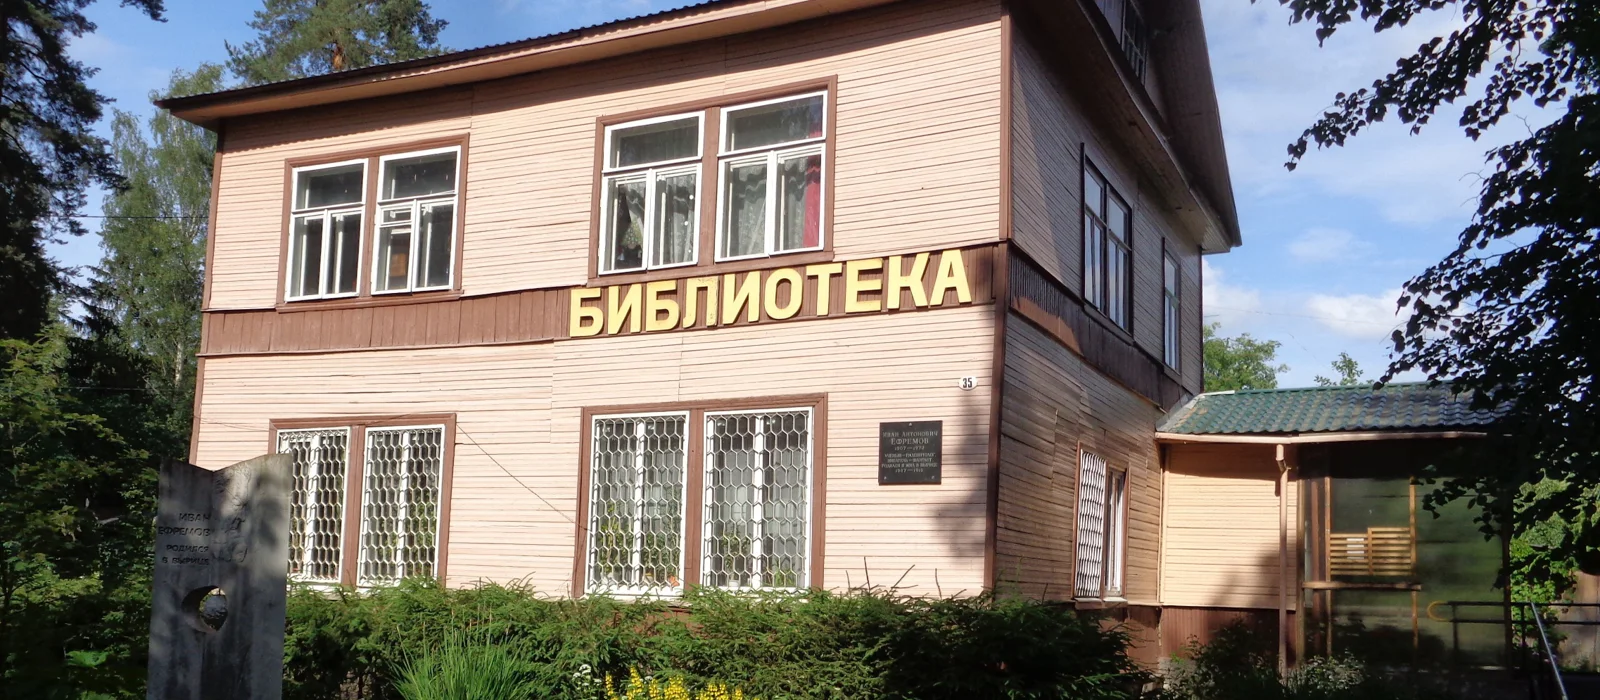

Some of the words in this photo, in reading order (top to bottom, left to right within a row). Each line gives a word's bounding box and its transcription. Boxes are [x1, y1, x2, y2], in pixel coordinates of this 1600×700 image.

[569, 249, 972, 337] БИБЛИОТЕКА
[962, 377, 973, 388] 35
[891, 437, 929, 445] ЕФРЕМОВ
[179, 513, 212, 522] ИВАН
[158, 527, 211, 536] ЕФРЕМОВ
